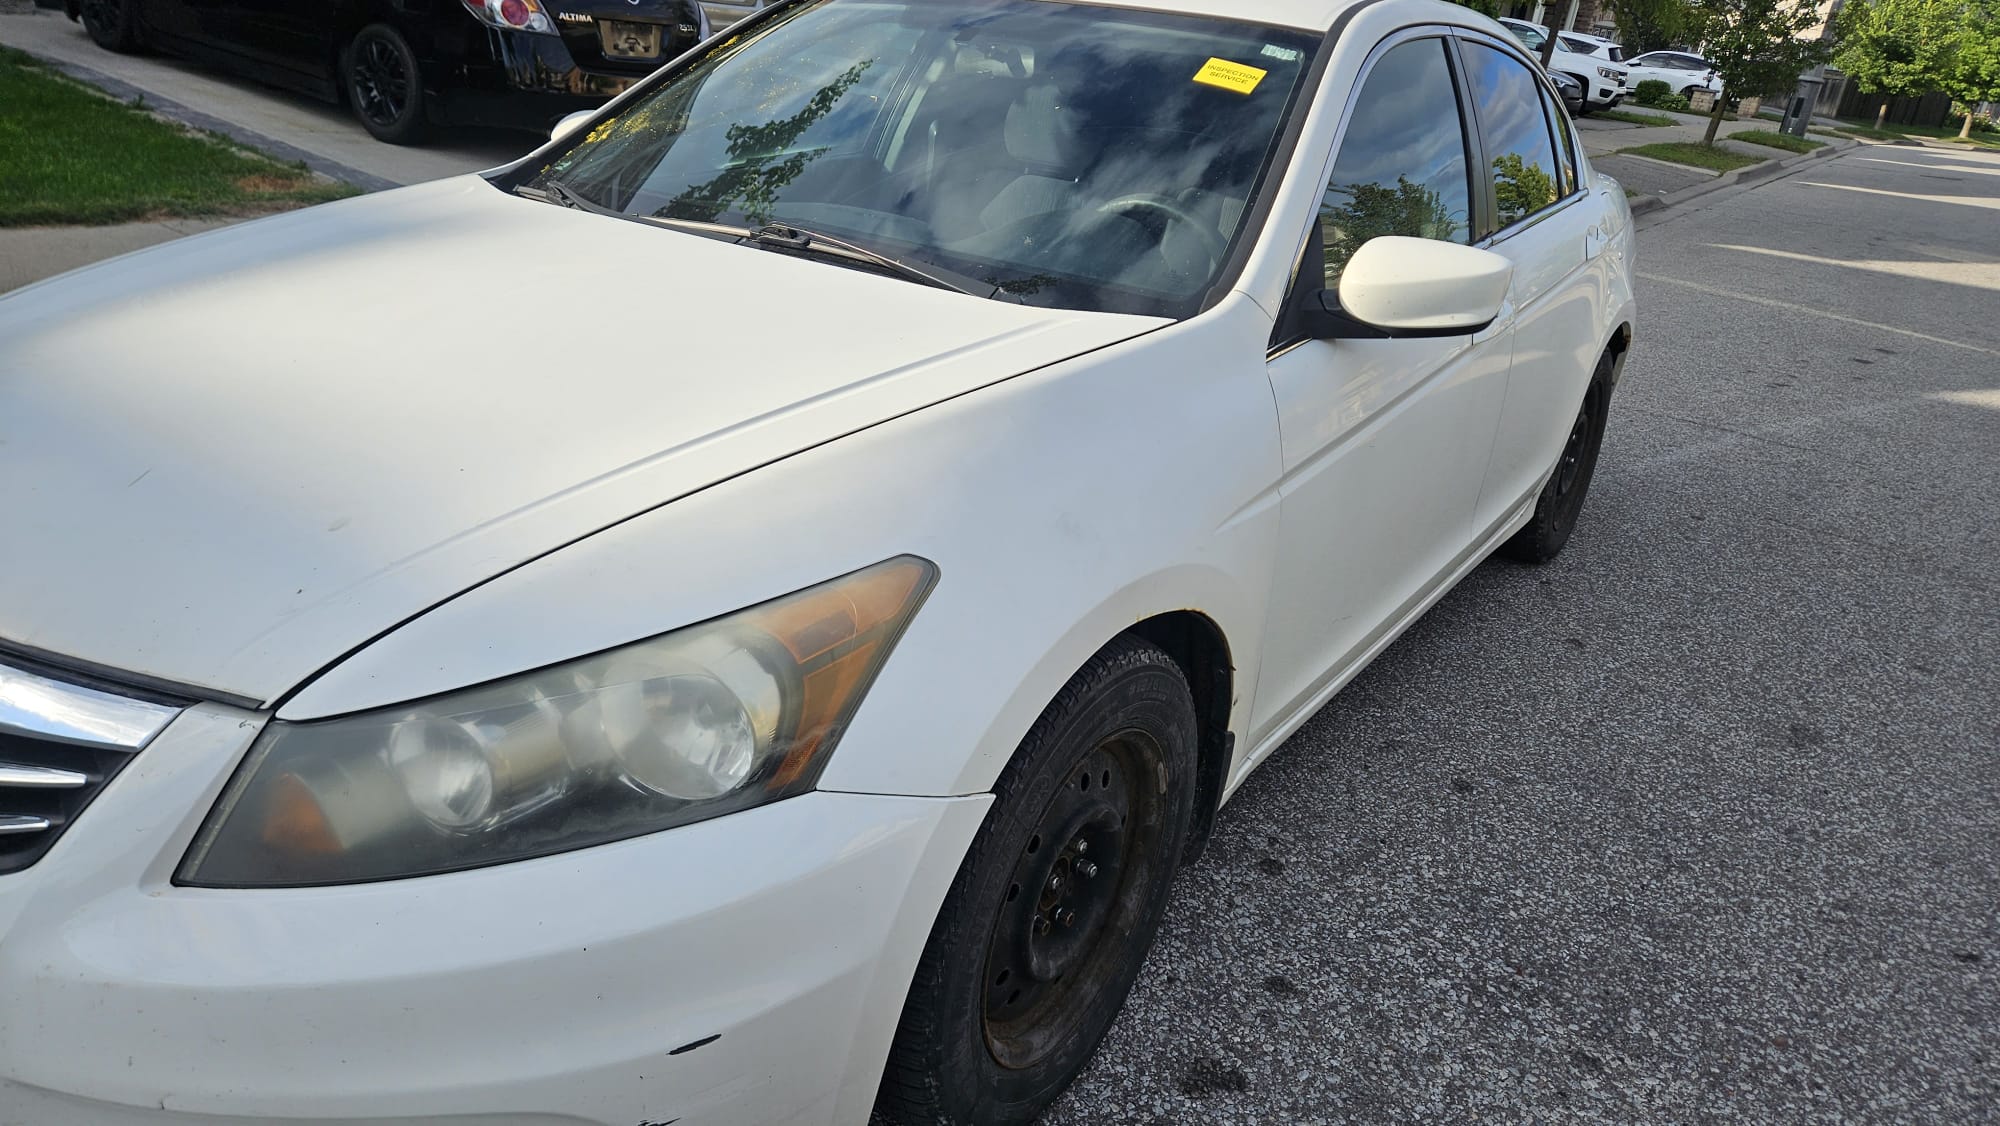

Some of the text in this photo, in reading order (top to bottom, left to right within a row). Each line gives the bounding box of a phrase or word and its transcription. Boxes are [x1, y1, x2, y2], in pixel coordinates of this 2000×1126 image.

[559, 12, 592, 23] ALTIMA
[1207, 64, 1259, 81] INSPECTION
[1209, 71, 1249, 84] SERVICE
